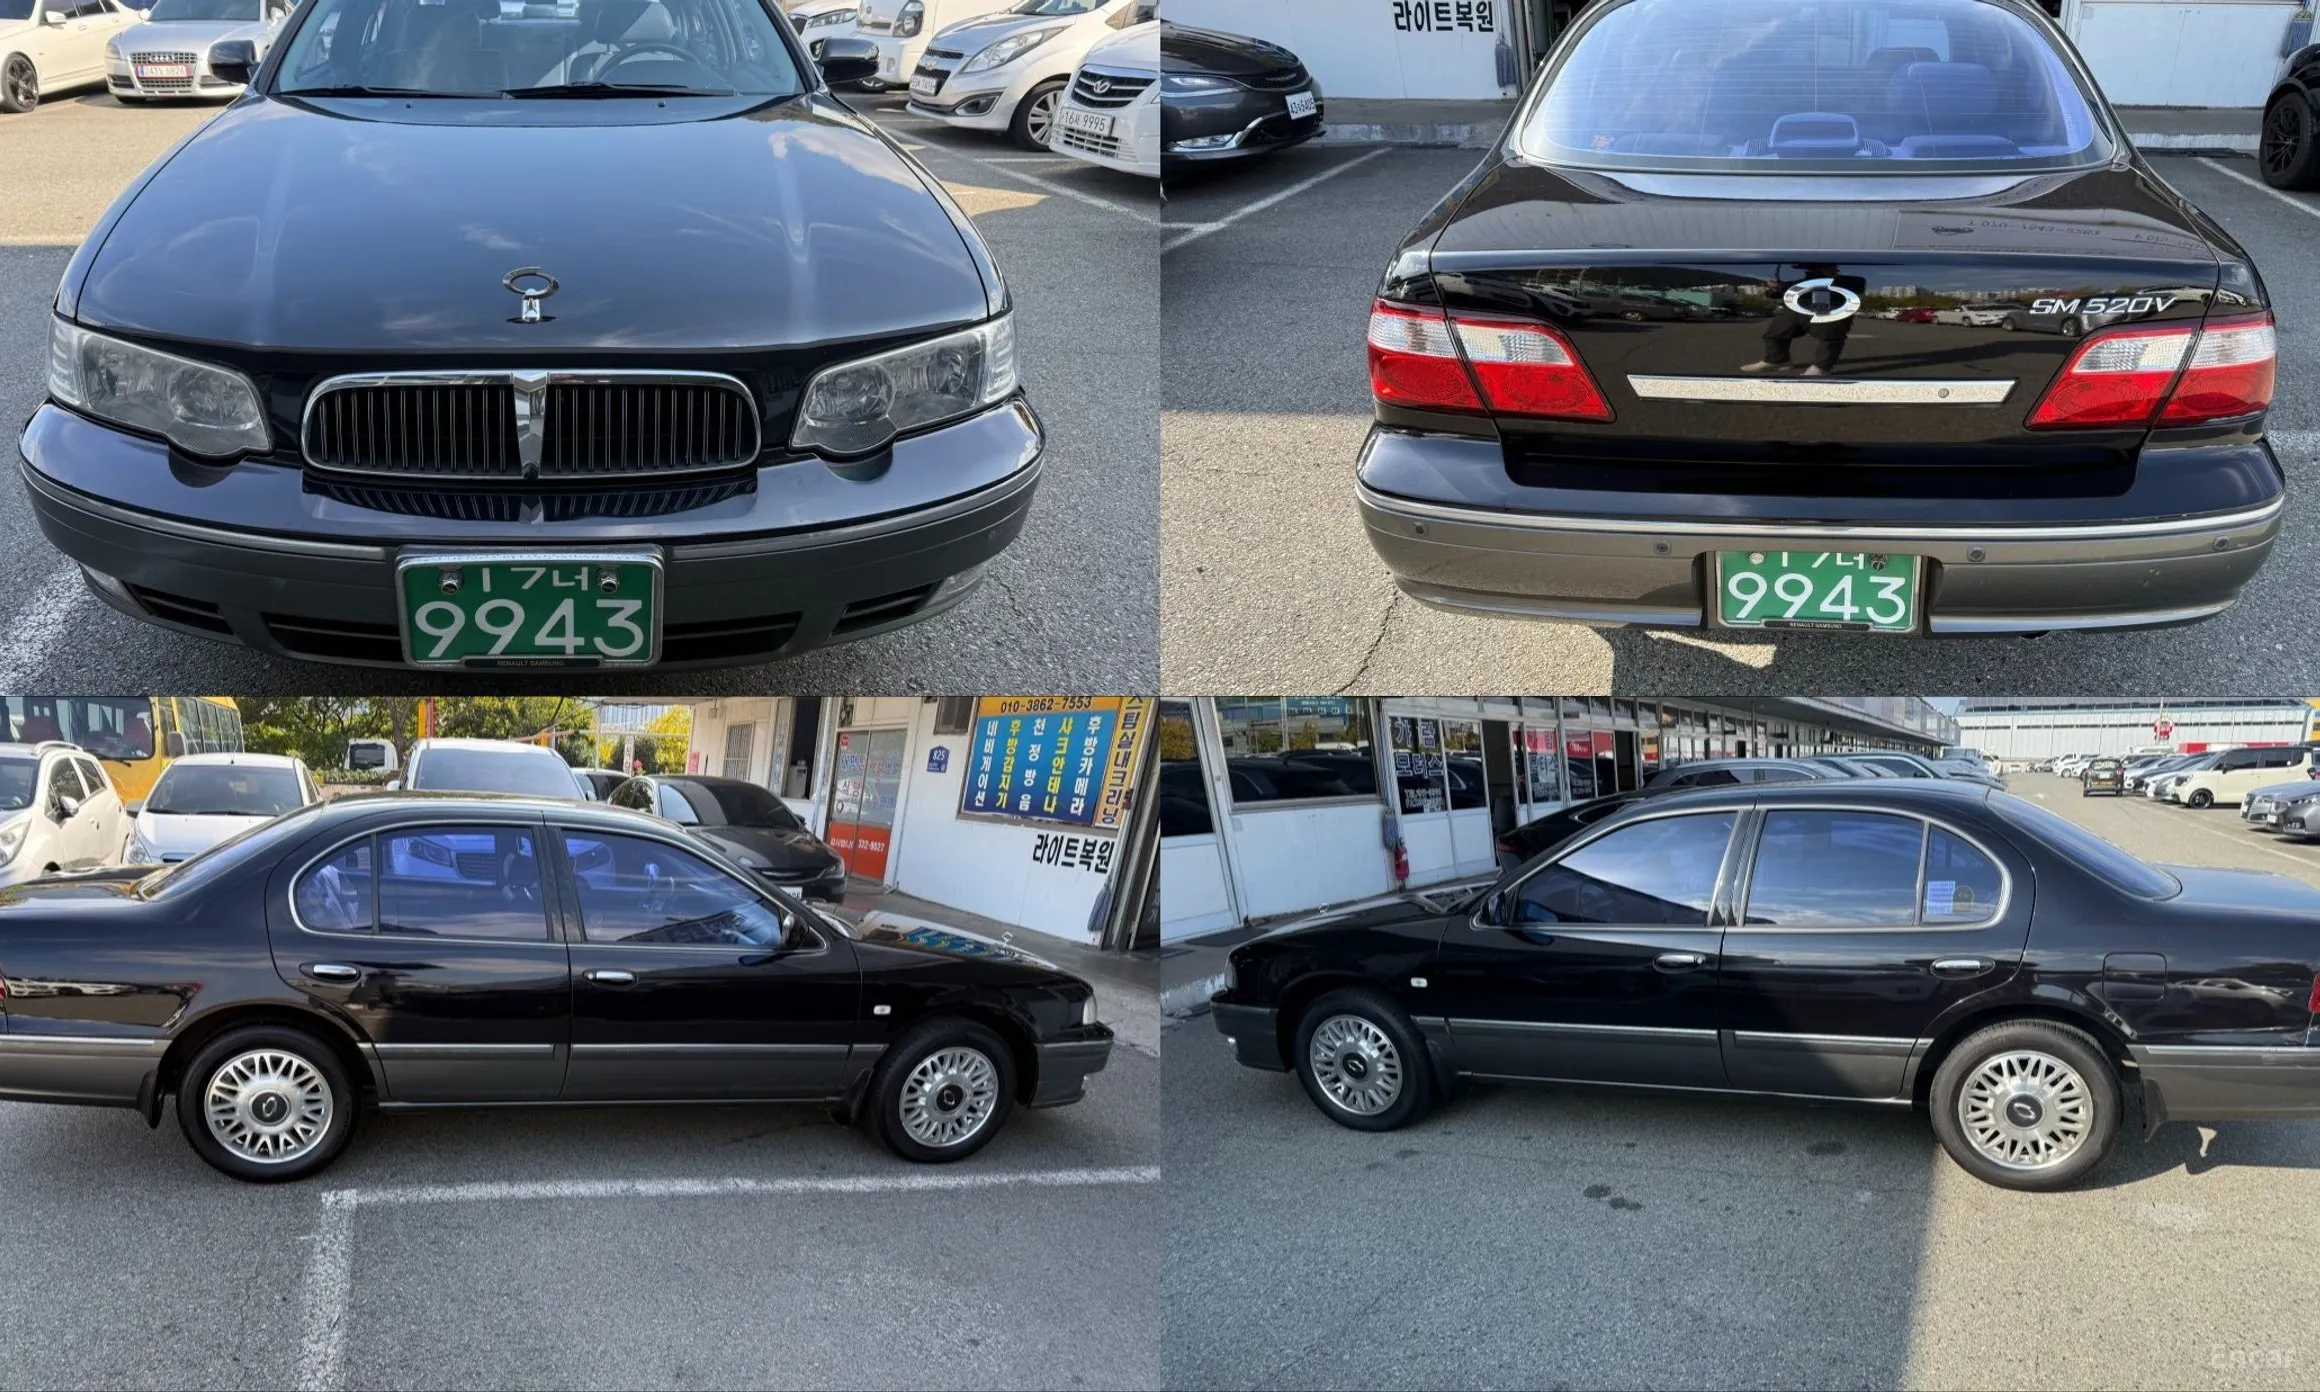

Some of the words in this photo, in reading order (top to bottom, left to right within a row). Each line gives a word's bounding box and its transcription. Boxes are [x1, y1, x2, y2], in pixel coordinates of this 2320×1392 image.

[1393, 0, 1494, 32] 라이트복원
[1083, 114, 1106, 132] 9995
[2029, 299, 2080, 314] SM
[2082, 297, 2178, 314] 520V
[481, 566, 589, 592] 17너
[1728, 571, 1906, 624] 9943
[414, 598, 644, 658] 9943
[1001, 697, 1091, 713] 010-3862-7553
[932, 750, 945, 760] 825
[974, 720, 998, 807] 네비게이션
[995, 719, 1022, 809] 후방감지기
[1018, 718, 1046, 811] 천정방음
[1069, 716, 1102, 816] 후방카메라
[1395, 753, 1445, 779] 모터스
[1032, 833, 1115, 874] 라이트복원
